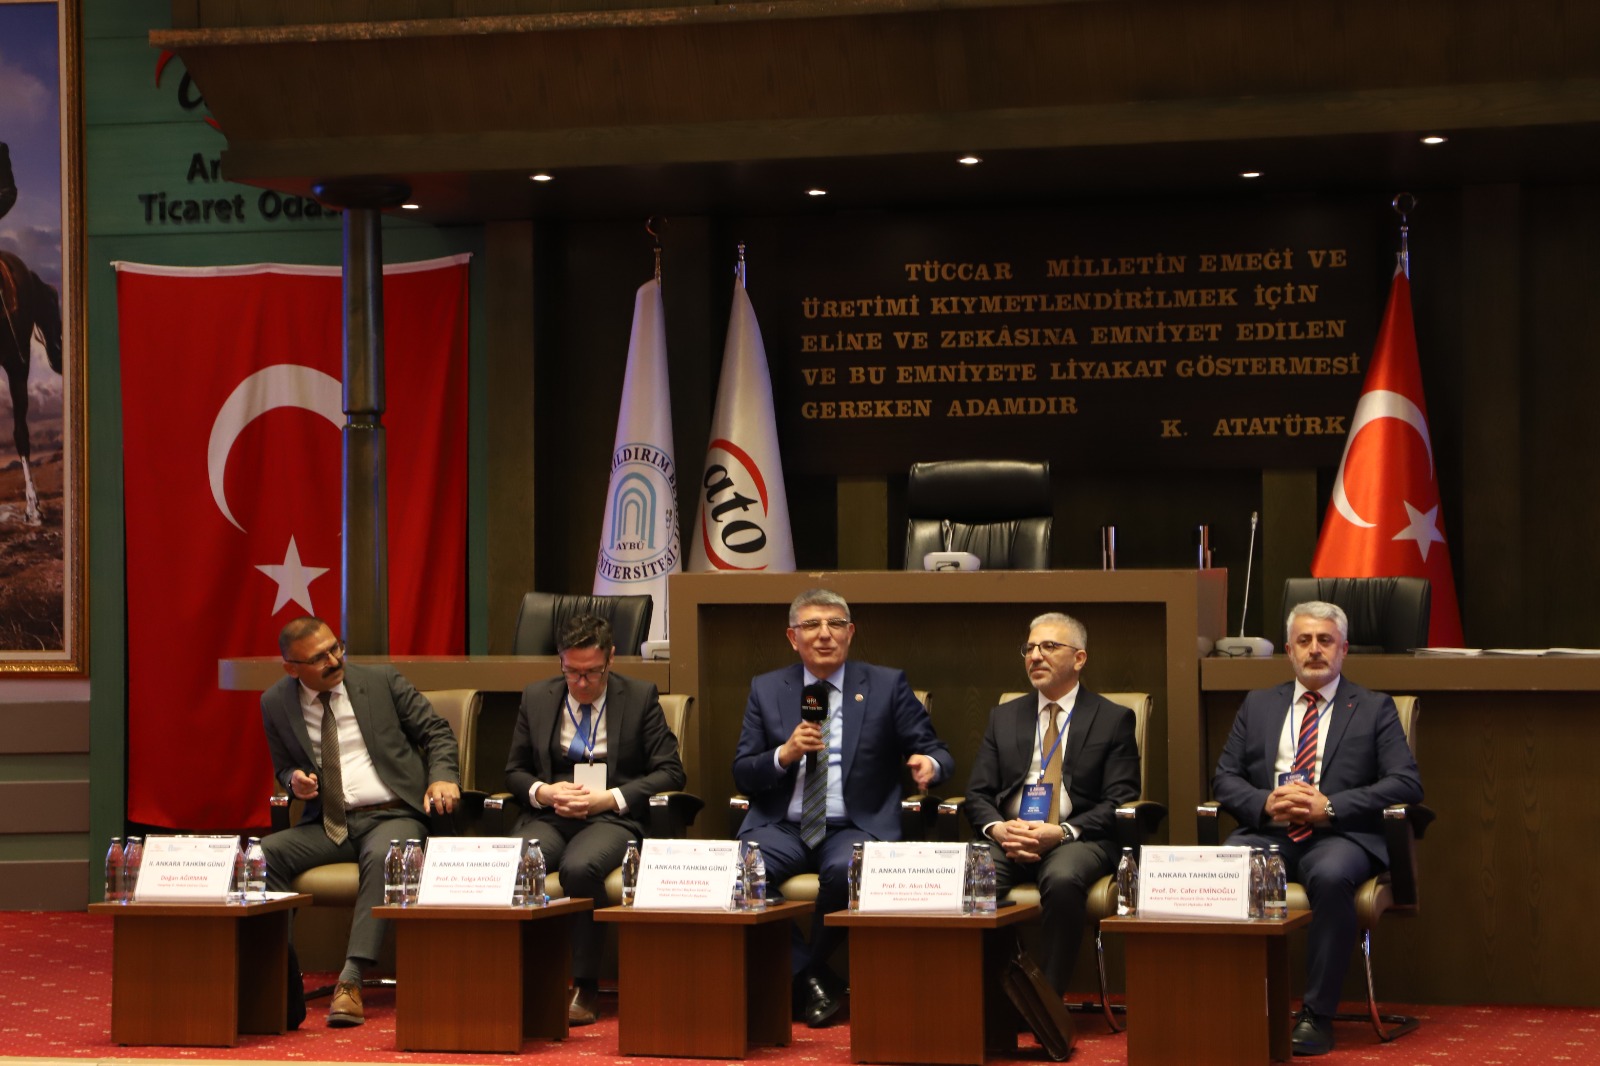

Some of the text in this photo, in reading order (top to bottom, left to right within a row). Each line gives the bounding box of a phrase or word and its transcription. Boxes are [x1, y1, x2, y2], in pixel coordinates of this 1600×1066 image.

[138, 192, 246, 224] Ticaret
[905, 248, 1347, 282] TÜCCAR MİLLETİN EMEĞİ VE
[801, 282, 1319, 319] ÜRETİMİ KIYMETLENDİRİLMEK İÇİN
[801, 319, 1346, 352] ELİNE VE ZEKÂSINA EMNİYET EDİLEN
[801, 352, 1361, 386] VE BU EMNİYETE LİYAKAT GÖSTERMESİ
[801, 397, 1078, 419] GEREKEN ADAMDIR
[1161, 414, 1346, 438] K. ATATÜRK
[703, 464, 767, 554] ato
[615, 540, 646, 551] AYBÜ
[155, 860, 181, 868] ANKARA
[182, 860, 206, 868] TAHKİM
[207, 860, 226, 868] GÜNÜ
[654, 863, 681, 871] ANKARA
[908, 866, 935, 874] TAHKİM
[935, 866, 956, 874] GÜNÜ
[1188, 871, 1217, 879] TAHKİM
[1218, 871, 1240, 879] GÜNÜ
